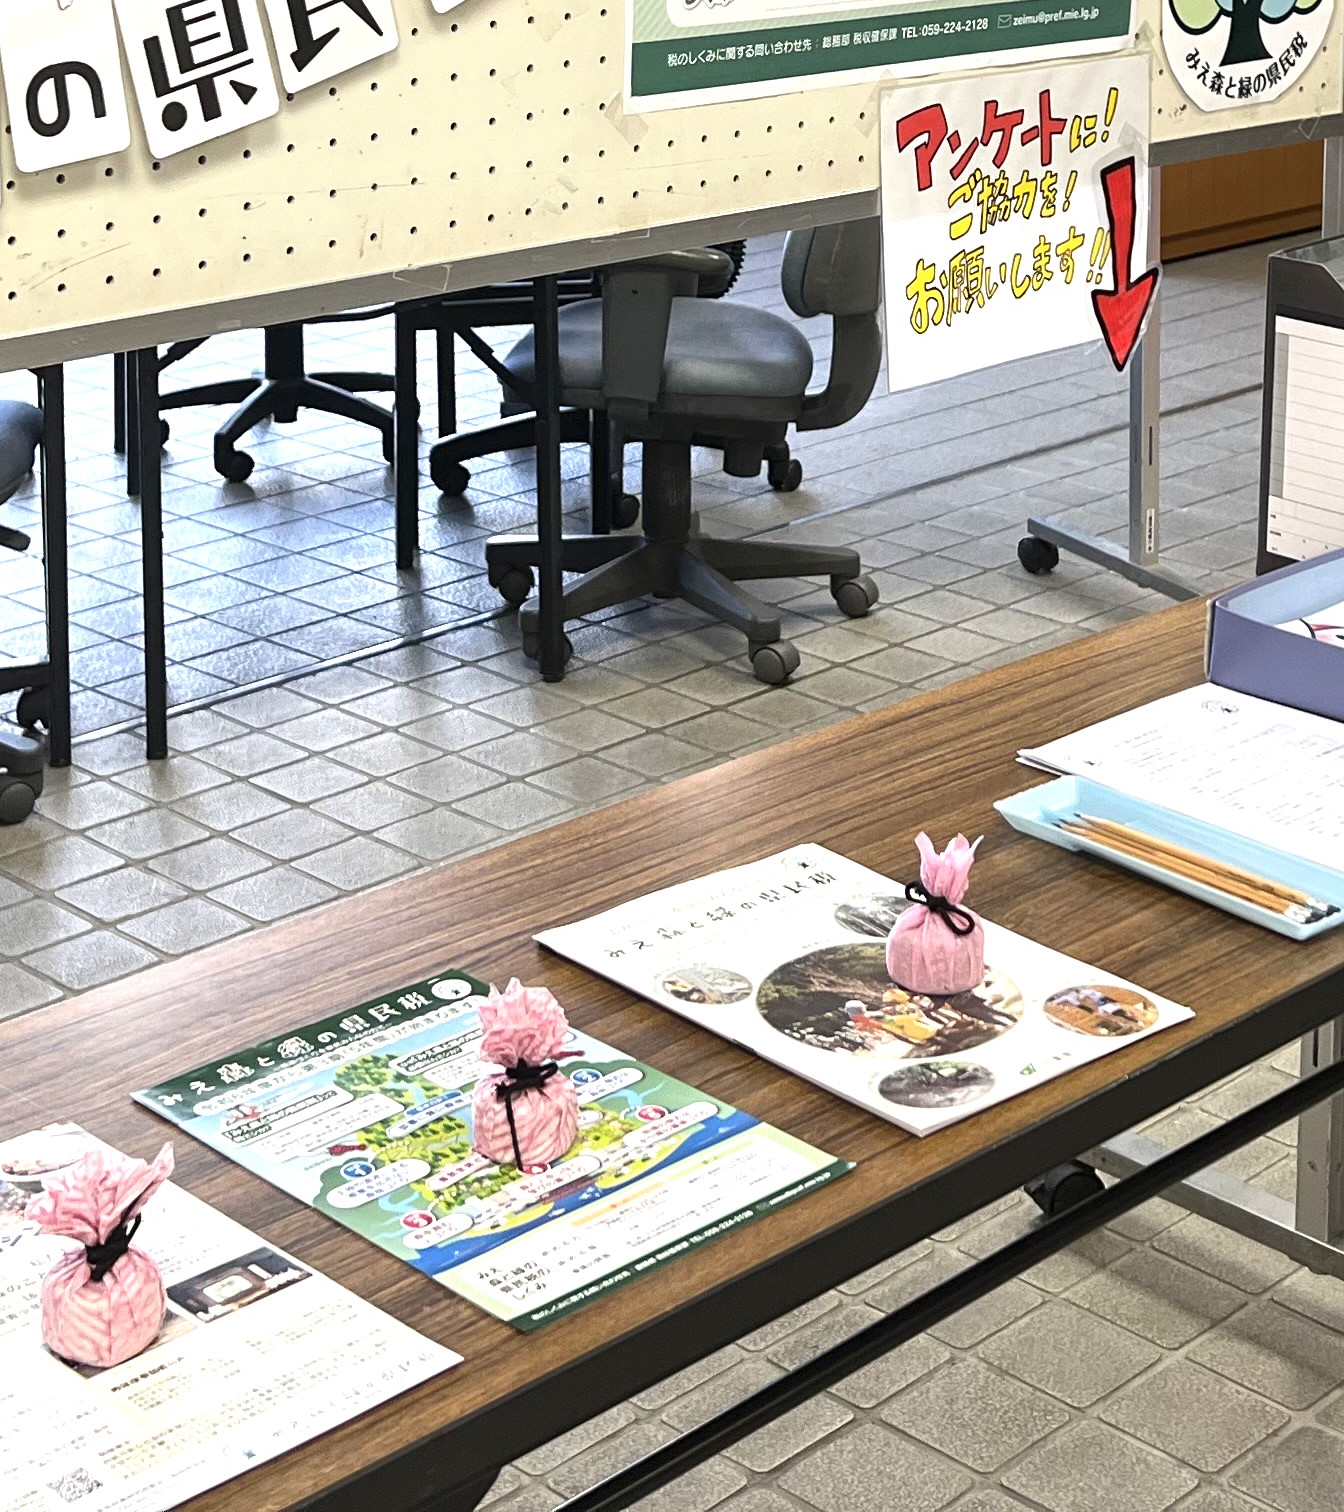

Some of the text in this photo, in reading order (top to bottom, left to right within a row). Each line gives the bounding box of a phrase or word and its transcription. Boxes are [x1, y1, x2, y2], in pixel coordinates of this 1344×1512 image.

[1185, 32, 1308, 99] みえ森と緑の県民税
[896, 87, 1118, 192] アンケートに!
[948, 168, 1078, 240] ご協力を!
